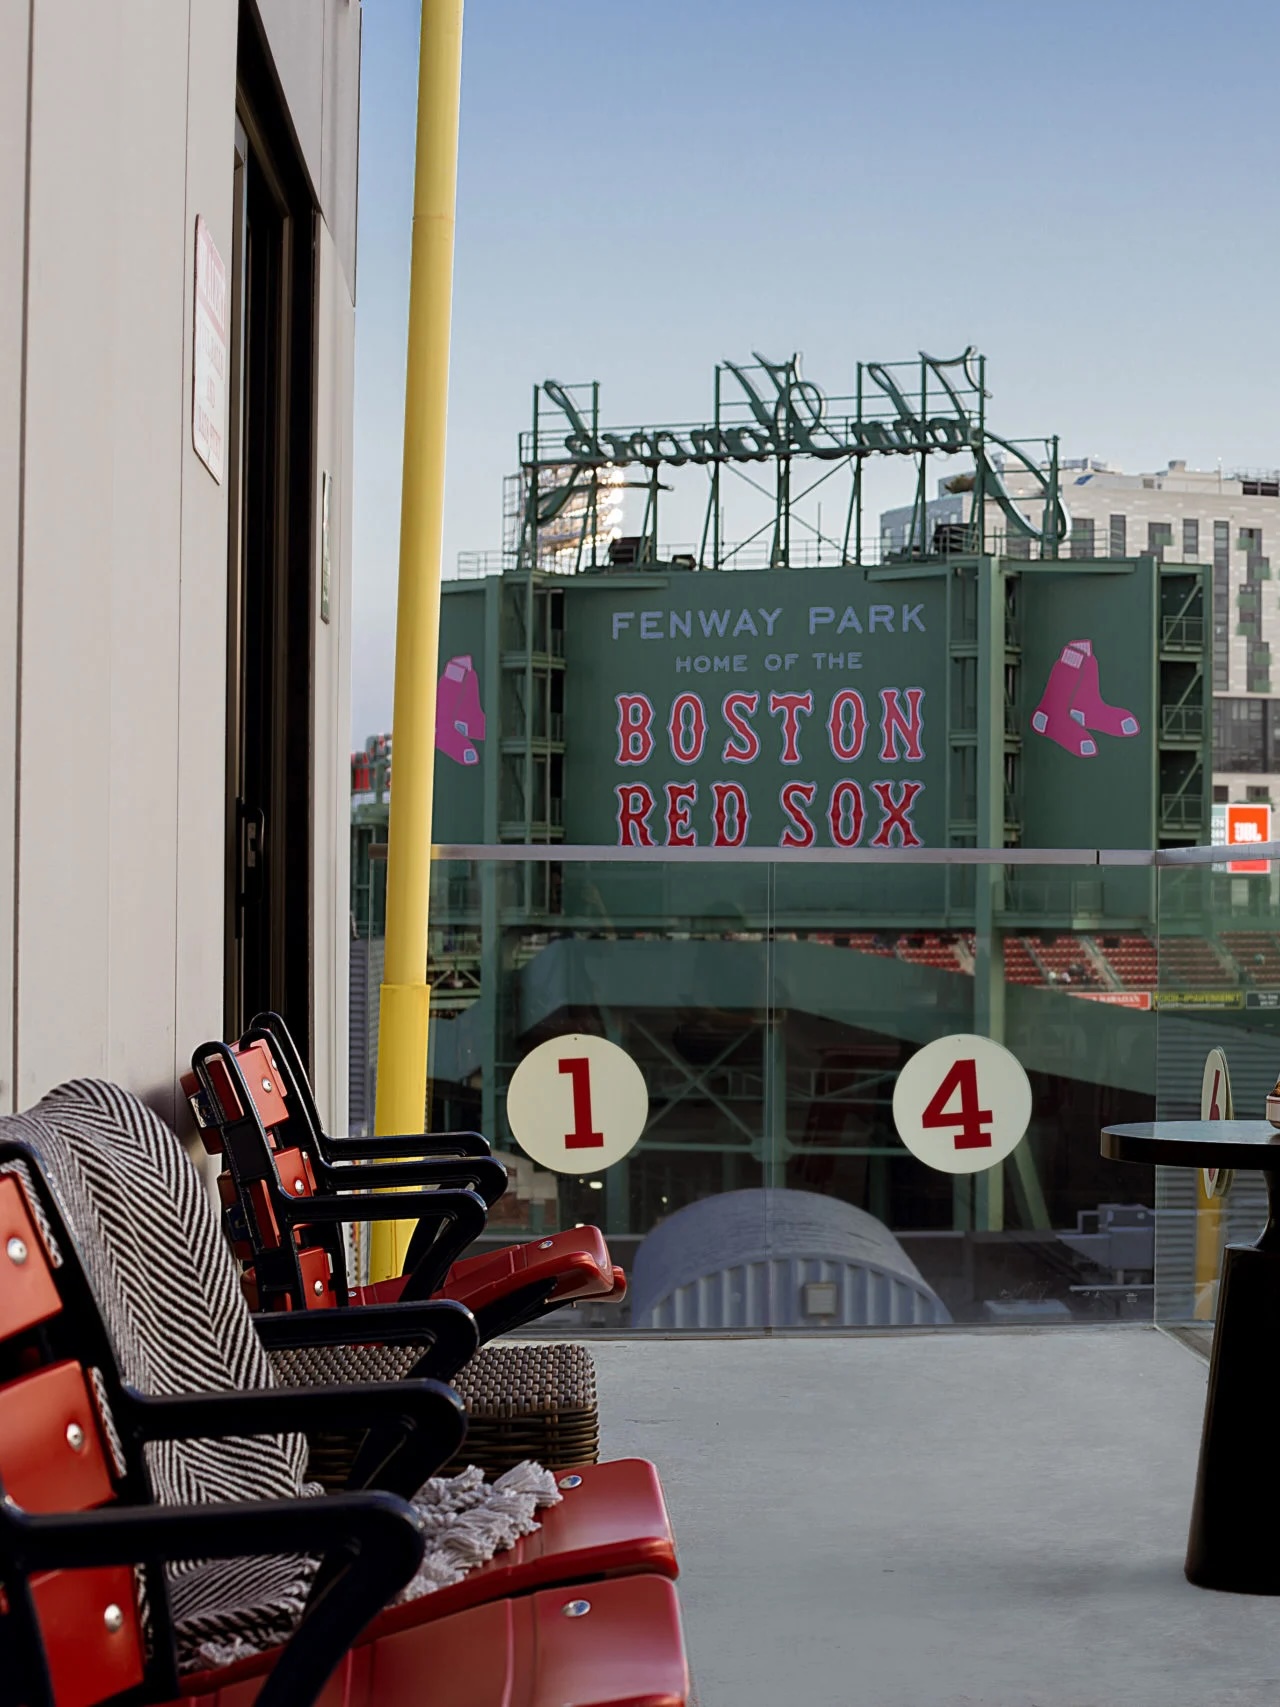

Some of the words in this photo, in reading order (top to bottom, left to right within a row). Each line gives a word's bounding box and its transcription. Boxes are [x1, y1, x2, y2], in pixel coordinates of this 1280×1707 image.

[611, 607, 783, 640] FENWAY
[808, 604, 928, 634] PARK
[675, 655, 748, 673] HOME
[764, 653, 799, 672] OF
[812, 651, 864, 671] THE
[614, 687, 926, 767] BOSTON
[614, 781, 752, 847] RED
[778, 780, 927, 847] SOX
[557, 1057, 605, 1150] 1
[921, 1059, 994, 1150] 4
